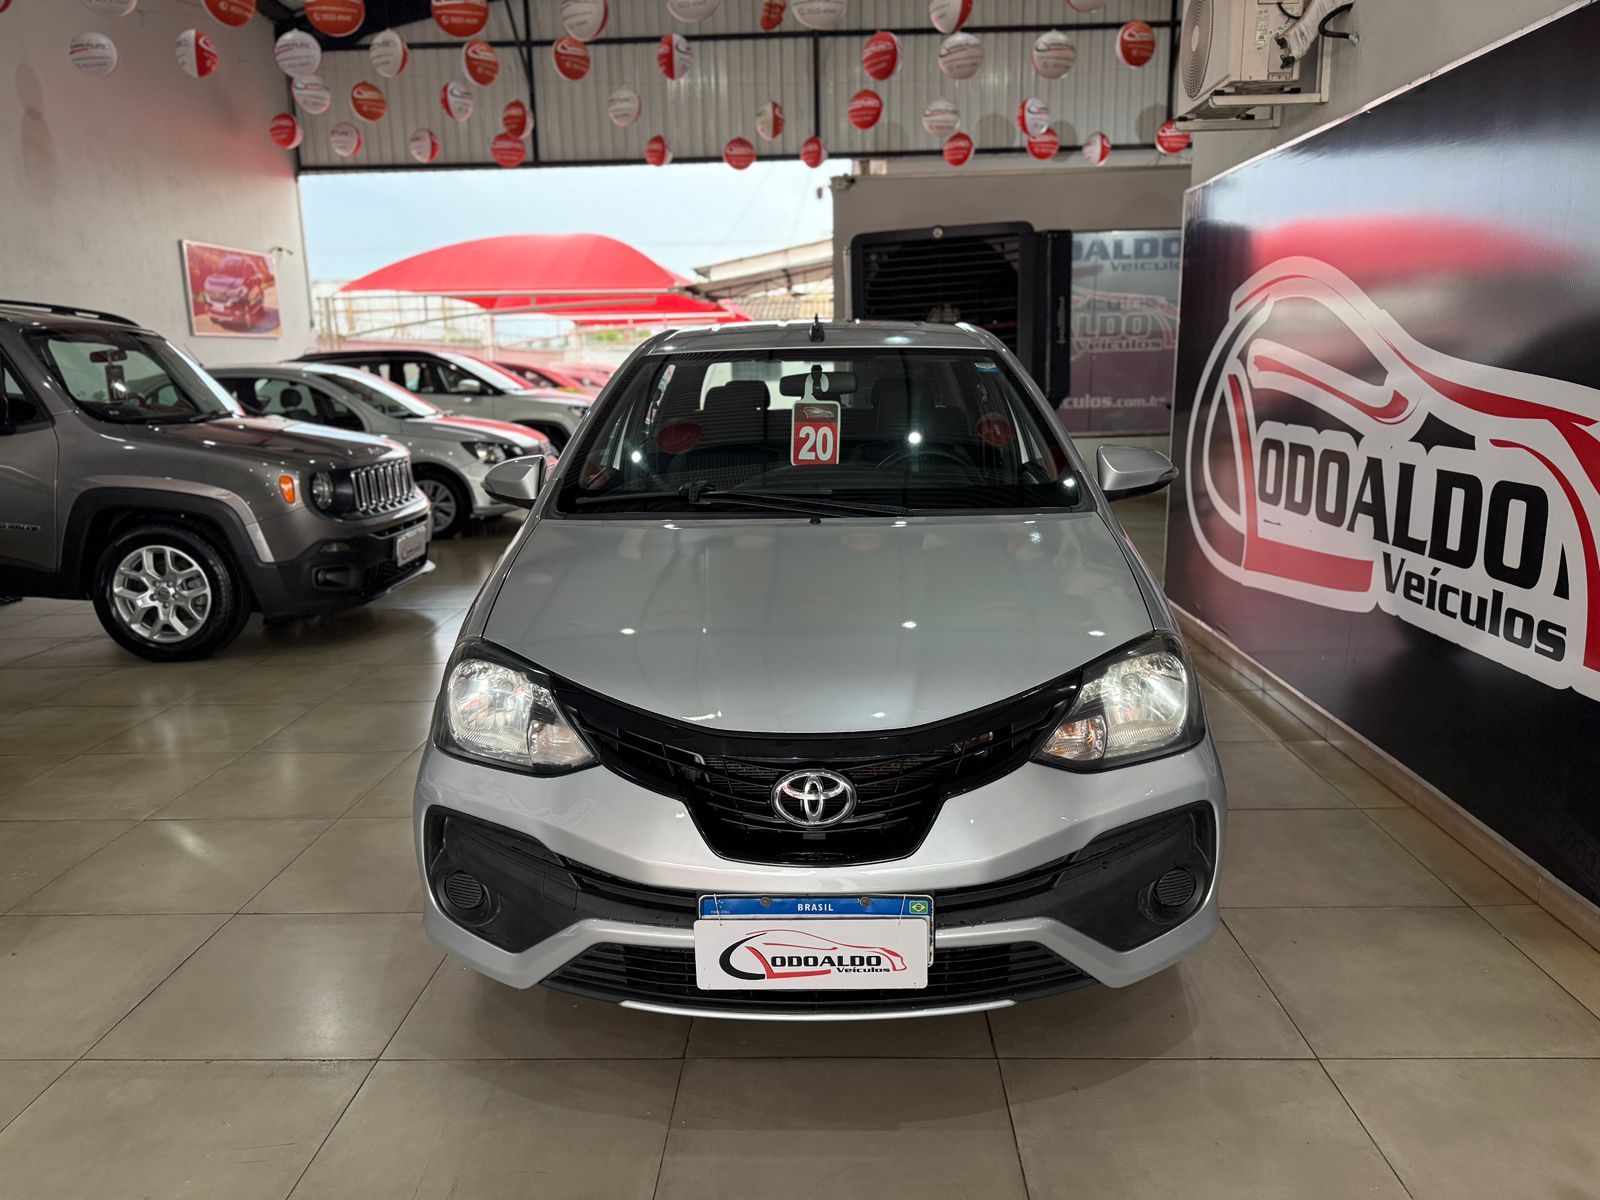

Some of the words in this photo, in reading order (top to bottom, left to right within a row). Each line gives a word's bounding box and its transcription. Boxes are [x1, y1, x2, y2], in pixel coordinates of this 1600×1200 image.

[798, 425, 834, 461] 20
[1382, 551, 1567, 662] Veículos
[797, 903, 834, 912] BRASIL
